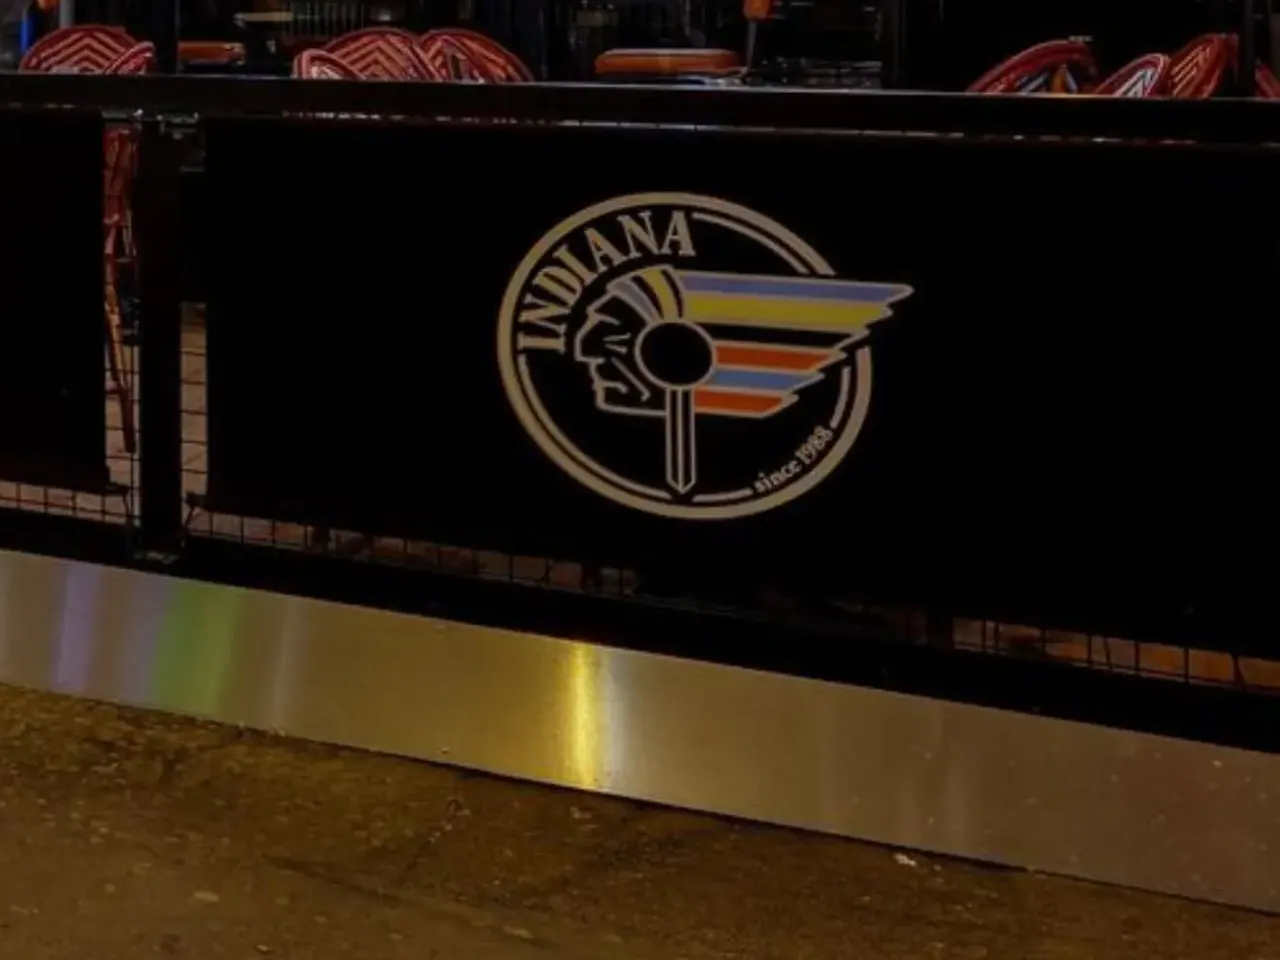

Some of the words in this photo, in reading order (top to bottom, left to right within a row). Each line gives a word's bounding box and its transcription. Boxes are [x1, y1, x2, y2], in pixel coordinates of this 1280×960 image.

[517, 210, 696, 353] INDIANA
[754, 460, 802, 493] since
[794, 426, 833, 464] 1988
